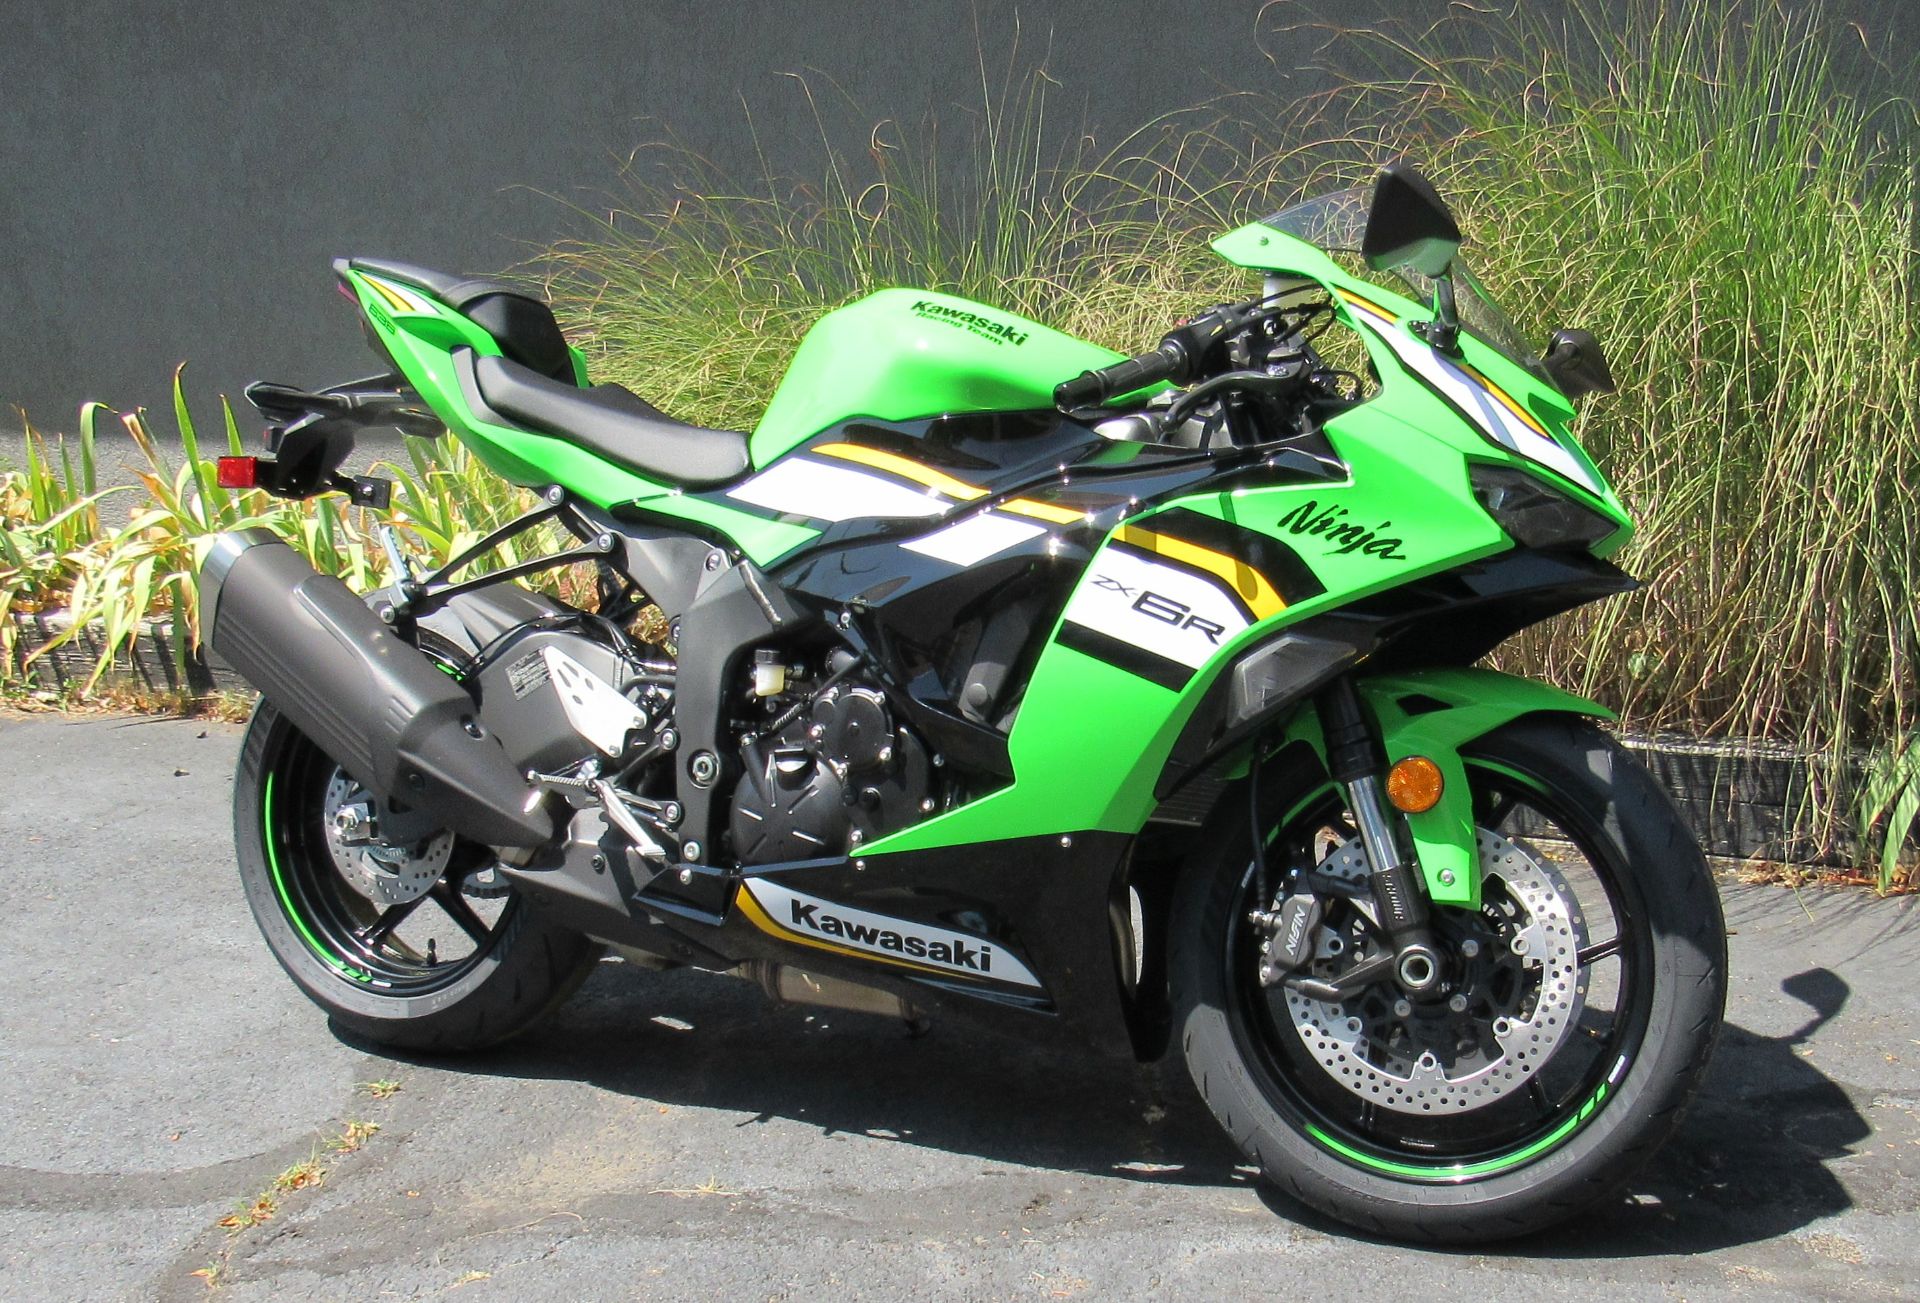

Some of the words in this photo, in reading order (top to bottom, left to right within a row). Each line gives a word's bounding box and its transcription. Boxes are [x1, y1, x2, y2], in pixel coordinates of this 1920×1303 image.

[910, 301, 1029, 346] Kawasaki
[916, 312, 963, 328] Racing
[967, 325, 1003, 345] Team
[1277, 500, 1407, 561] Ninja
[791, 898, 991, 972] Kawasaki
